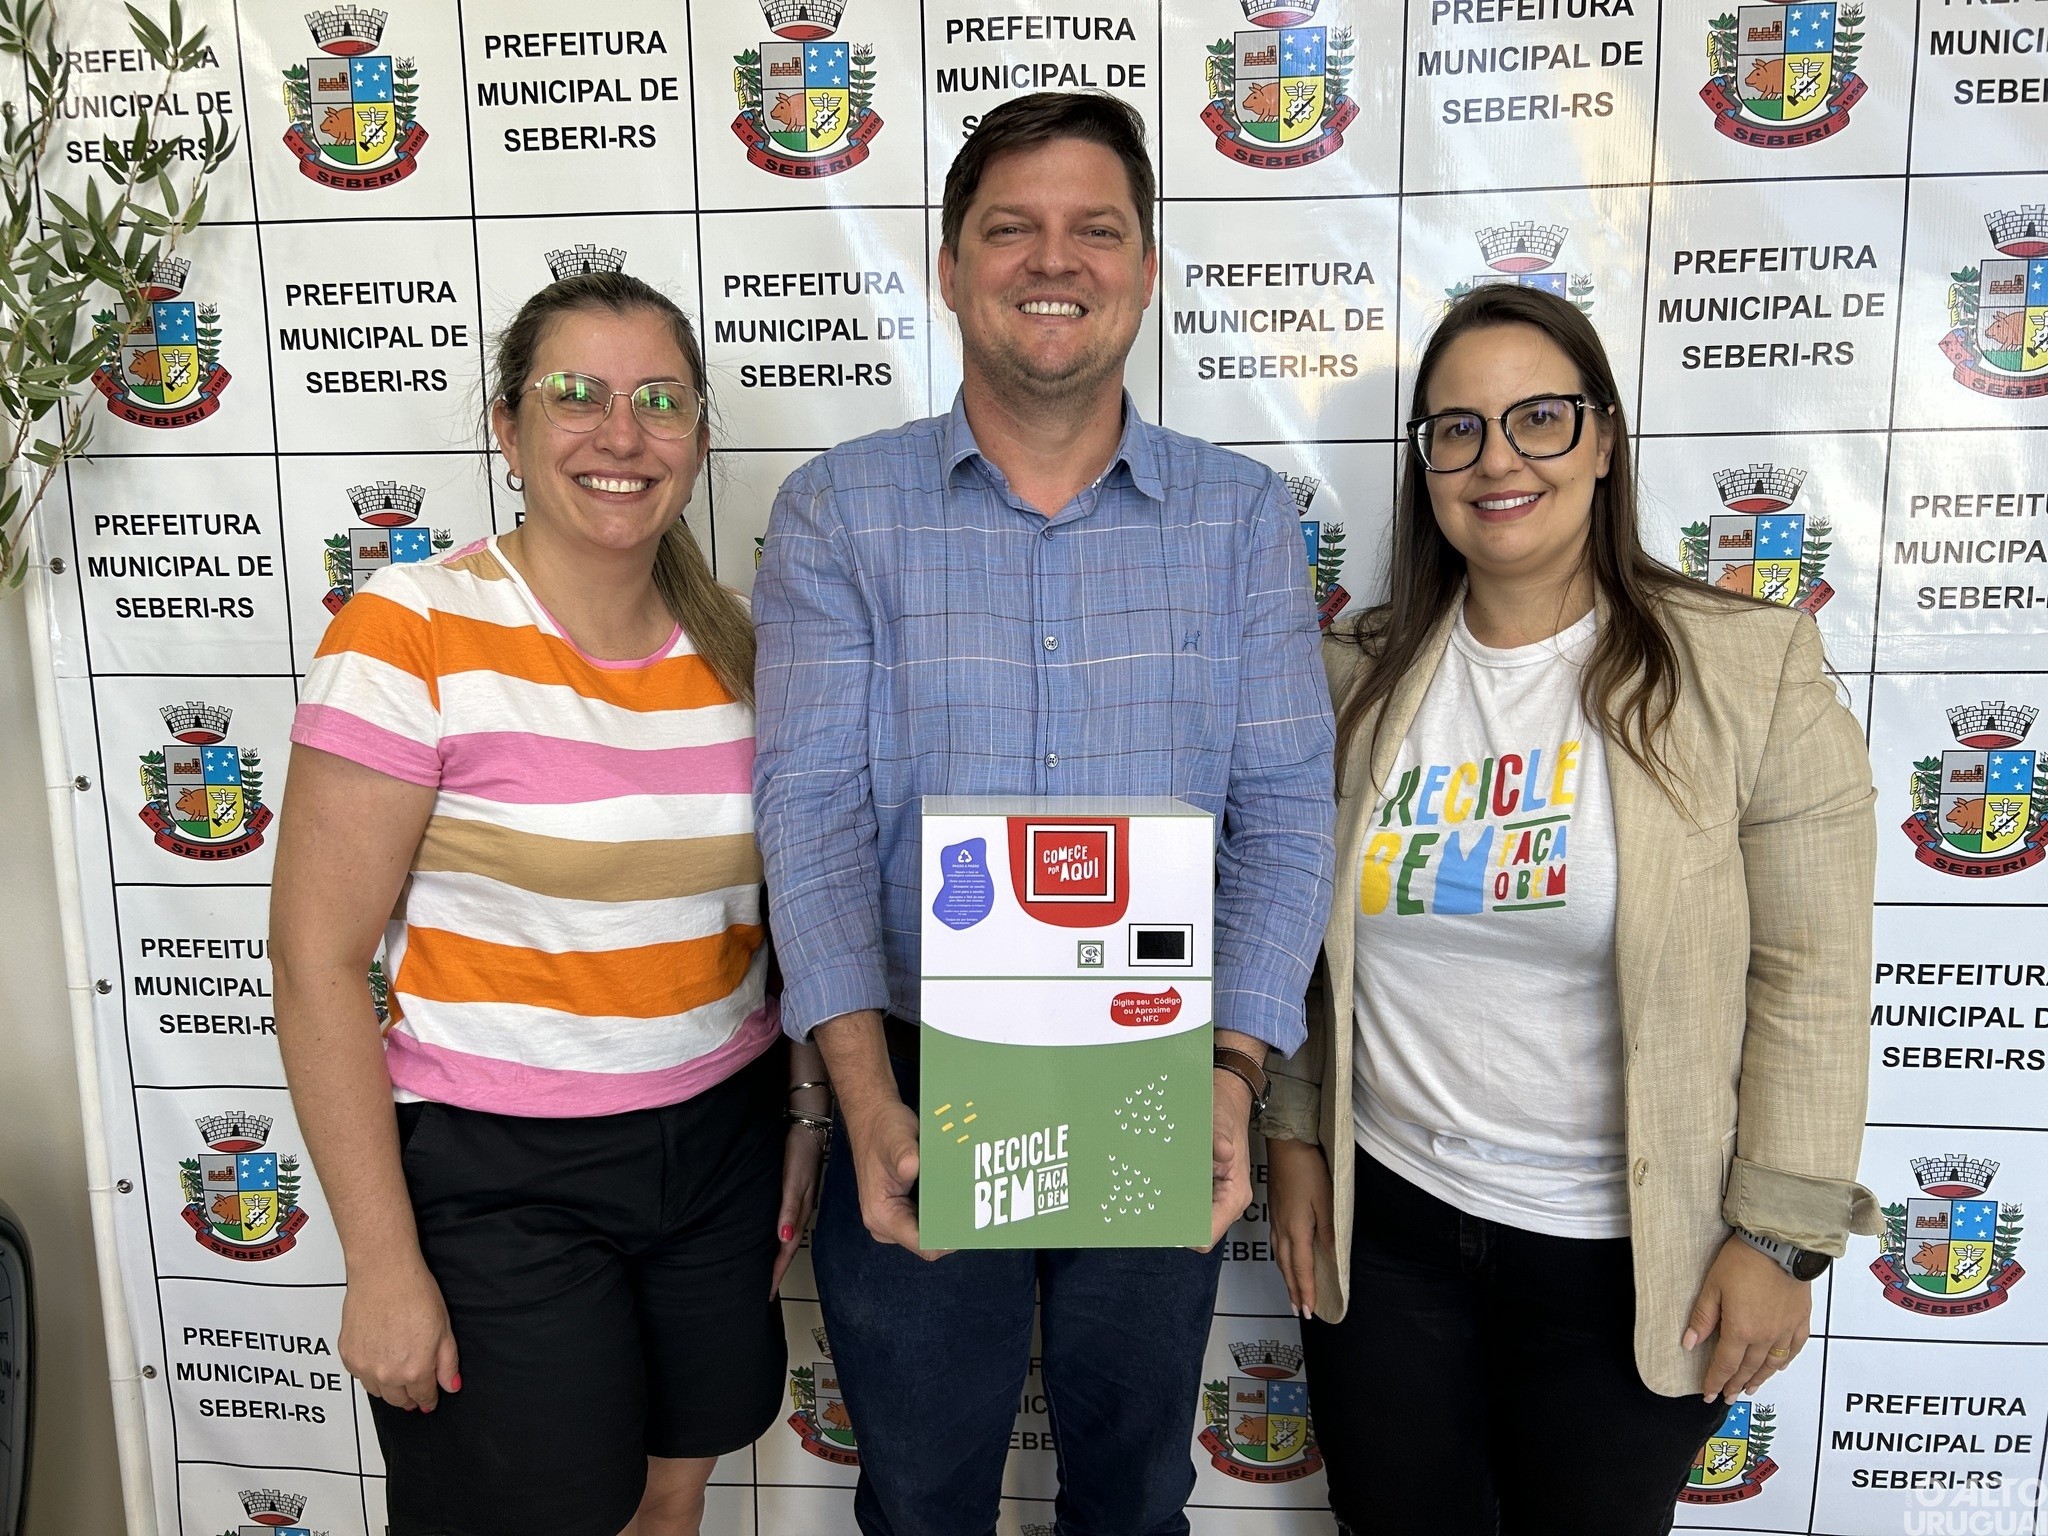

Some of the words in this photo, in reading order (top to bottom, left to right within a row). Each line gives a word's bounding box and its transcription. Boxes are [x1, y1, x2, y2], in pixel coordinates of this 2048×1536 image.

[947, 16, 1136, 44] PREFEITURA
[1930, 27, 2048, 55] MUNICI
[485, 31, 667, 58] PREFEITURA
[1418, 44, 1590, 76] MUNICIPAL
[1601, 41, 1643, 66] DE
[937, 63, 1097, 93] MUNICIPAL
[1107, 64, 1146, 88] DE
[197, 91, 233, 115] DE
[478, 79, 632, 106] MUNICIPAL
[643, 78, 678, 102] DE
[1954, 78, 2048, 105] SEBE
[1442, 92, 1613, 124] SEBERI-RS
[505, 125, 656, 152] SEBERI-RS
[1733, 123, 1831, 146] SEBERI
[765, 155, 853, 176] SEBERI
[1233, 144, 1326, 166] SEBERI
[316, 168, 402, 188] SEBERI
[1674, 245, 1877, 274] PREFEITURA
[724, 271, 904, 297] PREFEITURA
[1186, 262, 1374, 287] PREFEITURA
[286, 281, 457, 306] PREFEITURA
[1659, 295, 1831, 323] MUNICIPAL
[1843, 293, 1885, 317] DE
[715, 318, 868, 342] MUNICIPAL
[878, 317, 915, 340] DE
[1174, 309, 1335, 334] MUNICIPAL
[1345, 308, 1383, 331] DE
[280, 326, 423, 350] MUNICIPAL
[431, 325, 468, 347] DE
[1198, 354, 1358, 380] SEBERI-RS
[1682, 342, 1853, 369] SEBERI-RS
[307, 369, 447, 393] SEBERI-RS
[741, 363, 892, 387] SEBERI-RS
[1972, 378, 2048, 395] SEBE
[124, 407, 206, 426] SEBERI
[1910, 493, 2048, 518] PREFEIT
[95, 514, 261, 535] PREFEITURA
[88, 556, 230, 577] MUNICIPAL
[238, 556, 273, 576] DE
[116, 597, 254, 618] SEBERI-RS
[1917, 586, 2048, 609] SEBERI-
[1378, 740, 1581, 827] RECICLE
[171, 841, 250, 859] SEBERI
[1043, 844, 1088, 864] COMECE
[1497, 825, 1567, 868] FAÇA
[1048, 866, 1060, 875] POR
[1060, 857, 1099, 882] AQUI
[1360, 825, 1495, 916] BEM
[1933, 857, 2027, 875] SEBERI
[1494, 872, 1510, 900] O
[1516, 863, 1567, 900] BEM
[141, 938, 269, 959] PREFEITU
[134, 976, 272, 997] MUNICIPAL
[1875, 963, 2048, 986] PREFEITUR
[1113, 998, 1135, 1007] Digite
[1135, 1006, 1171, 1015] Aproxime
[1882, 1046, 2046, 1071] SEBERI-RS
[975, 1124, 1069, 1180] RECICLE
[1038, 1168, 1068, 1192] FAÇA
[975, 1169, 1036, 1230] BEM
[1038, 1193, 1045, 1209] O
[1047, 1188, 1069, 1208] BEM
[210, 1242, 282, 1260] SEBERI
[1900, 1296, 1991, 1314] SEBERI
[183, 1327, 332, 1356] PREFEITURA
[176, 1362, 304, 1388] MUNICIPAL
[310, 1371, 342, 1392] DE
[199, 1399, 326, 1424] SEBERI-RS
[1846, 1393, 2027, 1417] PREFEITURA
[1831, 1431, 1985, 1454] MUNICIPAL
[1994, 1434, 2033, 1454] DE
[1227, 1465, 1308, 1481] SEBERI
[1851, 1469, 2003, 1490] SEBERI-RS
